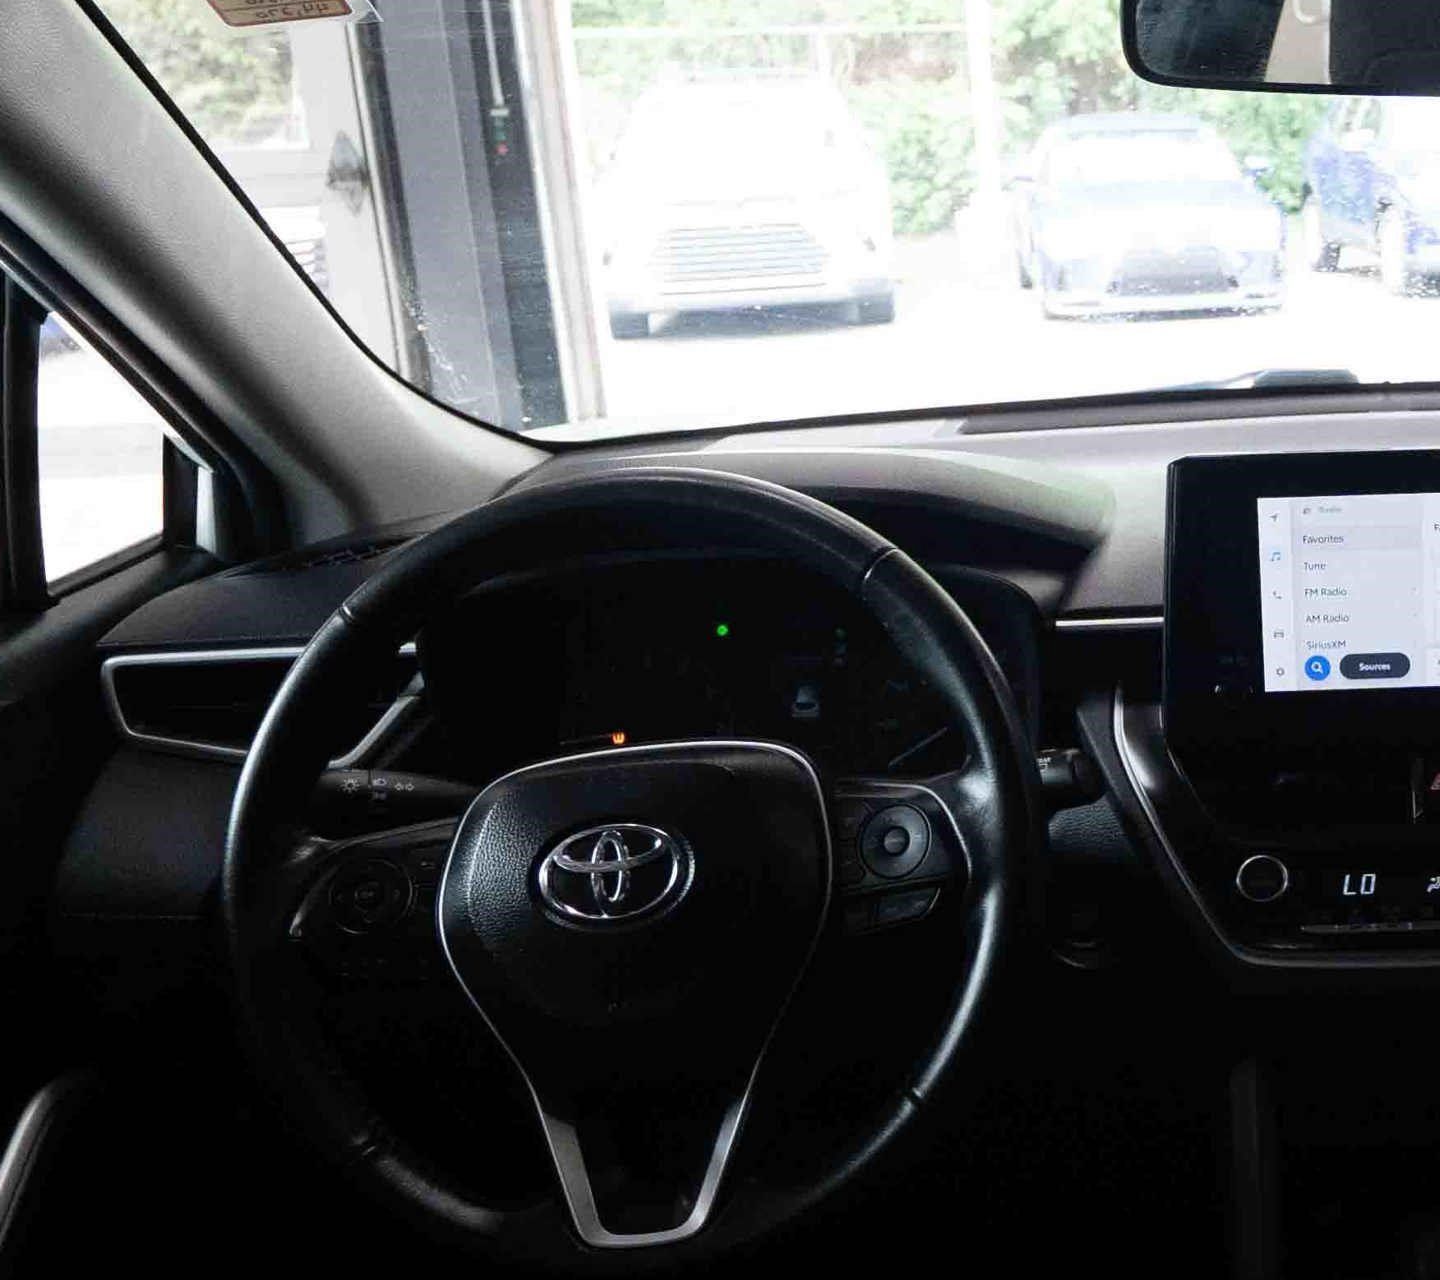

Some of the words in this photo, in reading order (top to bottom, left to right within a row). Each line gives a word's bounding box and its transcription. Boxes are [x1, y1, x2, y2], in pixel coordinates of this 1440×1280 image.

[1302, 535, 1345, 545] Favorites
[1304, 562, 1327, 571] Tune
[1304, 588, 1319, 597] FM
[1320, 587, 1348, 596] Radio
[1305, 615, 1321, 623] AM
[1323, 614, 1350, 623] Radio
[1306, 640, 1347, 650] SiriusXM
[1359, 662, 1391, 671] Sources
[1343, 873, 1377, 896] LO
